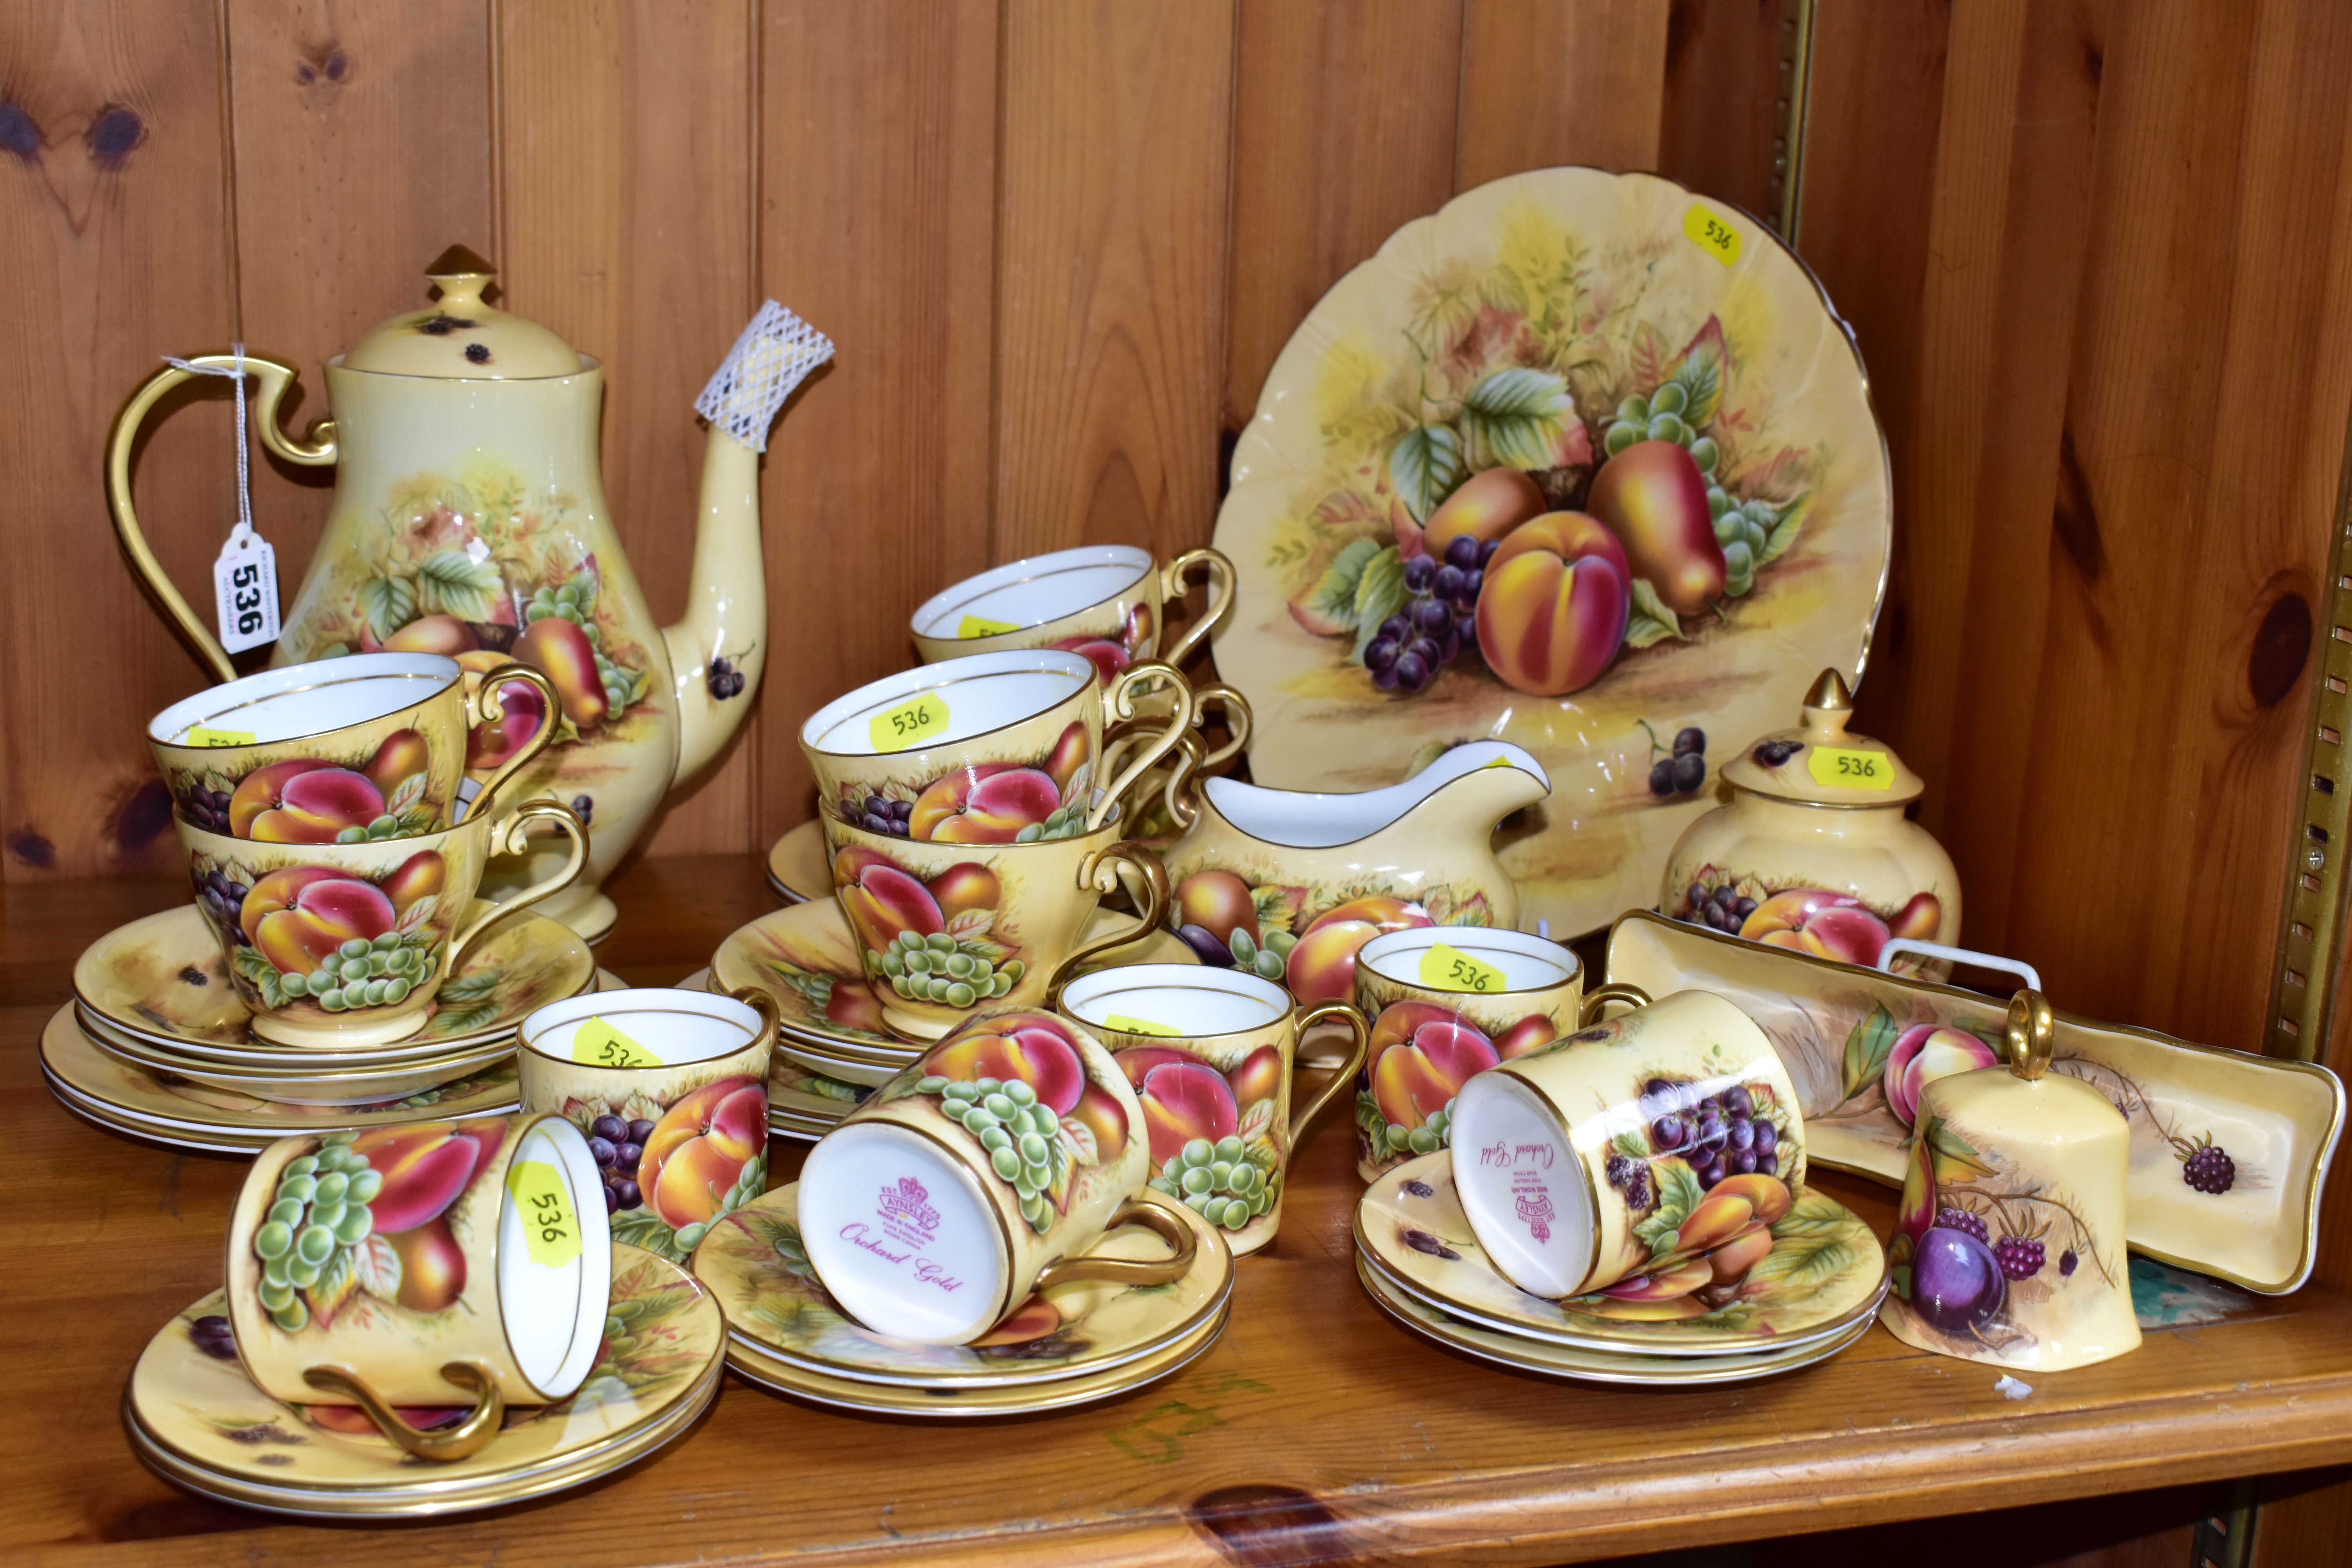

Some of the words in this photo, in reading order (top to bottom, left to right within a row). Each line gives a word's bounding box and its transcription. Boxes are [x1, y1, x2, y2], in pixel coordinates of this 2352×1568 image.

[1705, 220, 1731, 249] 536
[261, 550, 270, 588] RICHARD
[223, 577, 236, 635] AUCTIONEERS
[234, 564, 263, 635] 536
[265, 589, 274, 637] WINTERTON
[892, 705, 929, 735] 536
[1838, 757, 1875, 776] 536
[1449, 959, 1490, 990] 536
[1481, 1141, 1511, 1167] Gold
[1514, 1143, 1553, 1169] Orchard
[532, 1193, 567, 1242] 536
[887, 1198, 933, 1223] AYNSLEY
[924, 1203, 940, 1219] 1775
[1517, 1212, 1530, 1223] 1775
[1520, 1201, 1548, 1214] AYNSLEY
[877, 1209, 895, 1222] MADE
[905, 1223, 935, 1241] ENGLAND
[883, 1221, 897, 1231] FINE
[899, 1229, 925, 1245] ENGLISH
[884, 1229, 900, 1240] BONE
[902, 1238, 921, 1250] CHINA
[840, 1223, 911, 1264] Orchard
[914, 1258, 963, 1292] Gold
